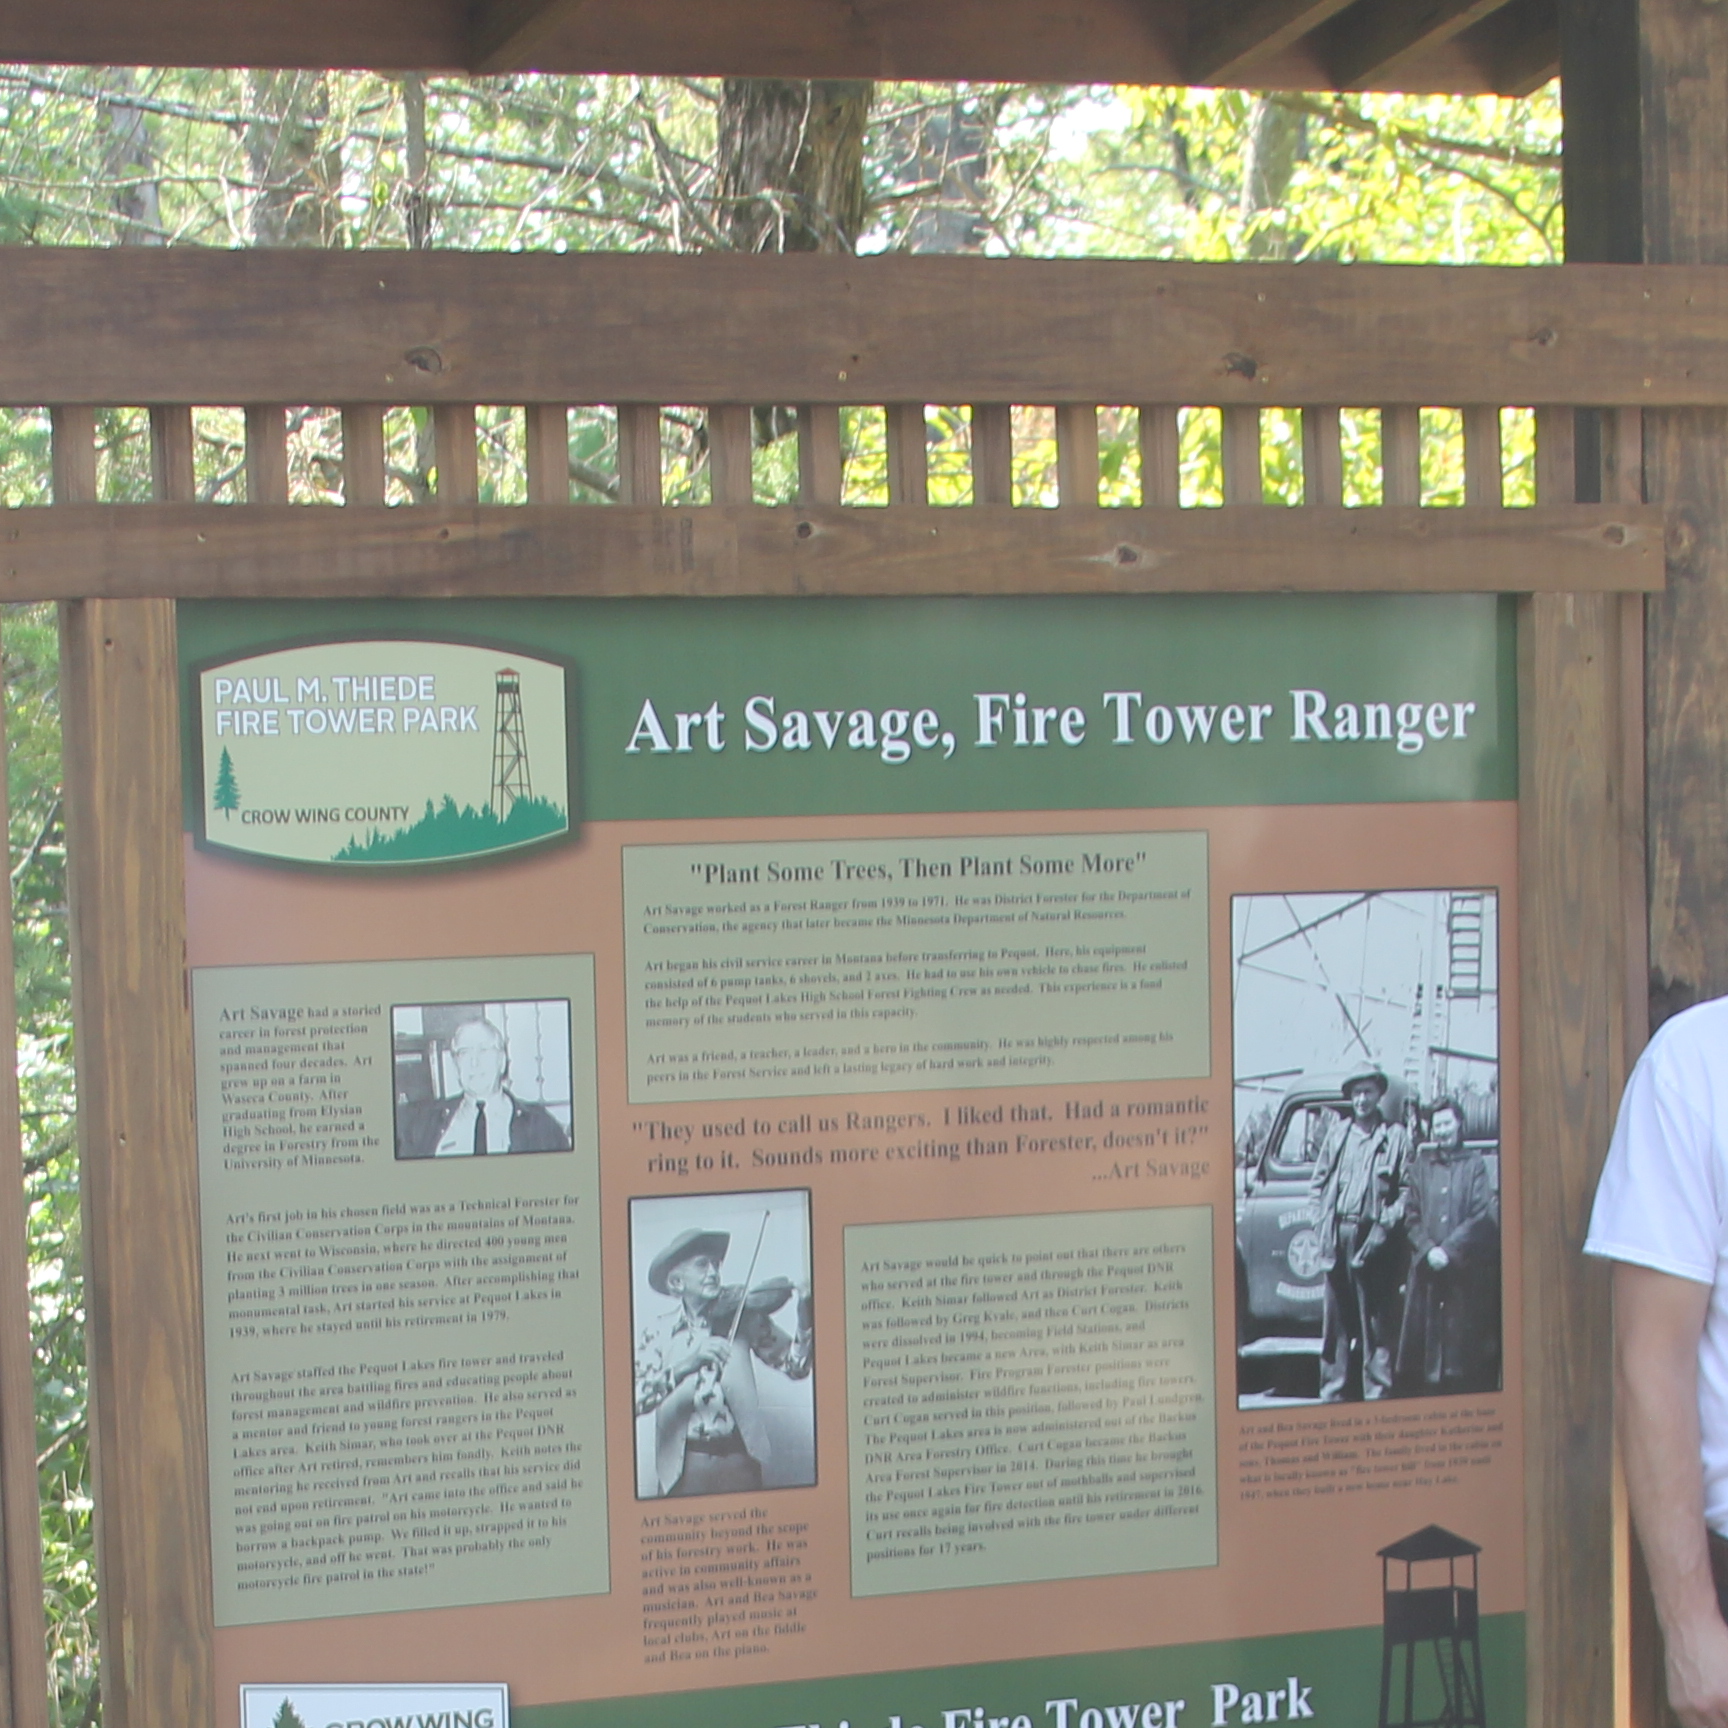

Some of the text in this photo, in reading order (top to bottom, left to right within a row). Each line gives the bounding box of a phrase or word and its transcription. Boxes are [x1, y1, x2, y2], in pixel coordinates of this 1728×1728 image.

[215, 674, 435, 704] PAUL M. THIEDE
[216, 705, 479, 736] FIRE TOWER PARK
[626, 689, 1475, 763] Art Savage, Fire Tower Ranger
[239, 805, 411, 824] CROW WING COUNTY
[690, 851, 1146, 885] "Plant Some Trees, Then Plant Some More"
[643, 888, 1191, 917] Art Savage worked as a Forest Ranger from 1939 to 1971. He was District Forester for the Department of
[643, 909, 1126, 934] Conservation, the agency that later became the Minnesota Department of Natural Resources.
[219, 1004, 381, 1022] Art Savage had a storied
[219, 1023, 368, 1040] career in forest protection
[219, 1039, 345, 1056] and management that
[219, 1055, 372, 1074] spanned four decades. Art
[220, 1072, 341, 1091] grew up on a farm in
[221, 1089, 349, 1105] Waseca County. After
[221, 1105, 362, 1124] graduating from Elysian
[632, 1095, 1209, 1145] "They used to call us Rangers. I liked that. Had a romantic
[222, 1120, 365, 1140] High School, he earned a
[222, 1136, 379, 1156] degree in Forestry from the
[647, 1124, 1208, 1178] ring to it. Sounds more exciting than Forester, doesn't it?"
[223, 1154, 364, 1171] University of Minnesota.
[1091, 1158, 1210, 1181] ...Art Savage
[640, 1507, 768, 1528] Art Savage served the
[866, 1542, 986, 1563] positions for 17 years.
[1209, 1677, 1312, 1726] Park
